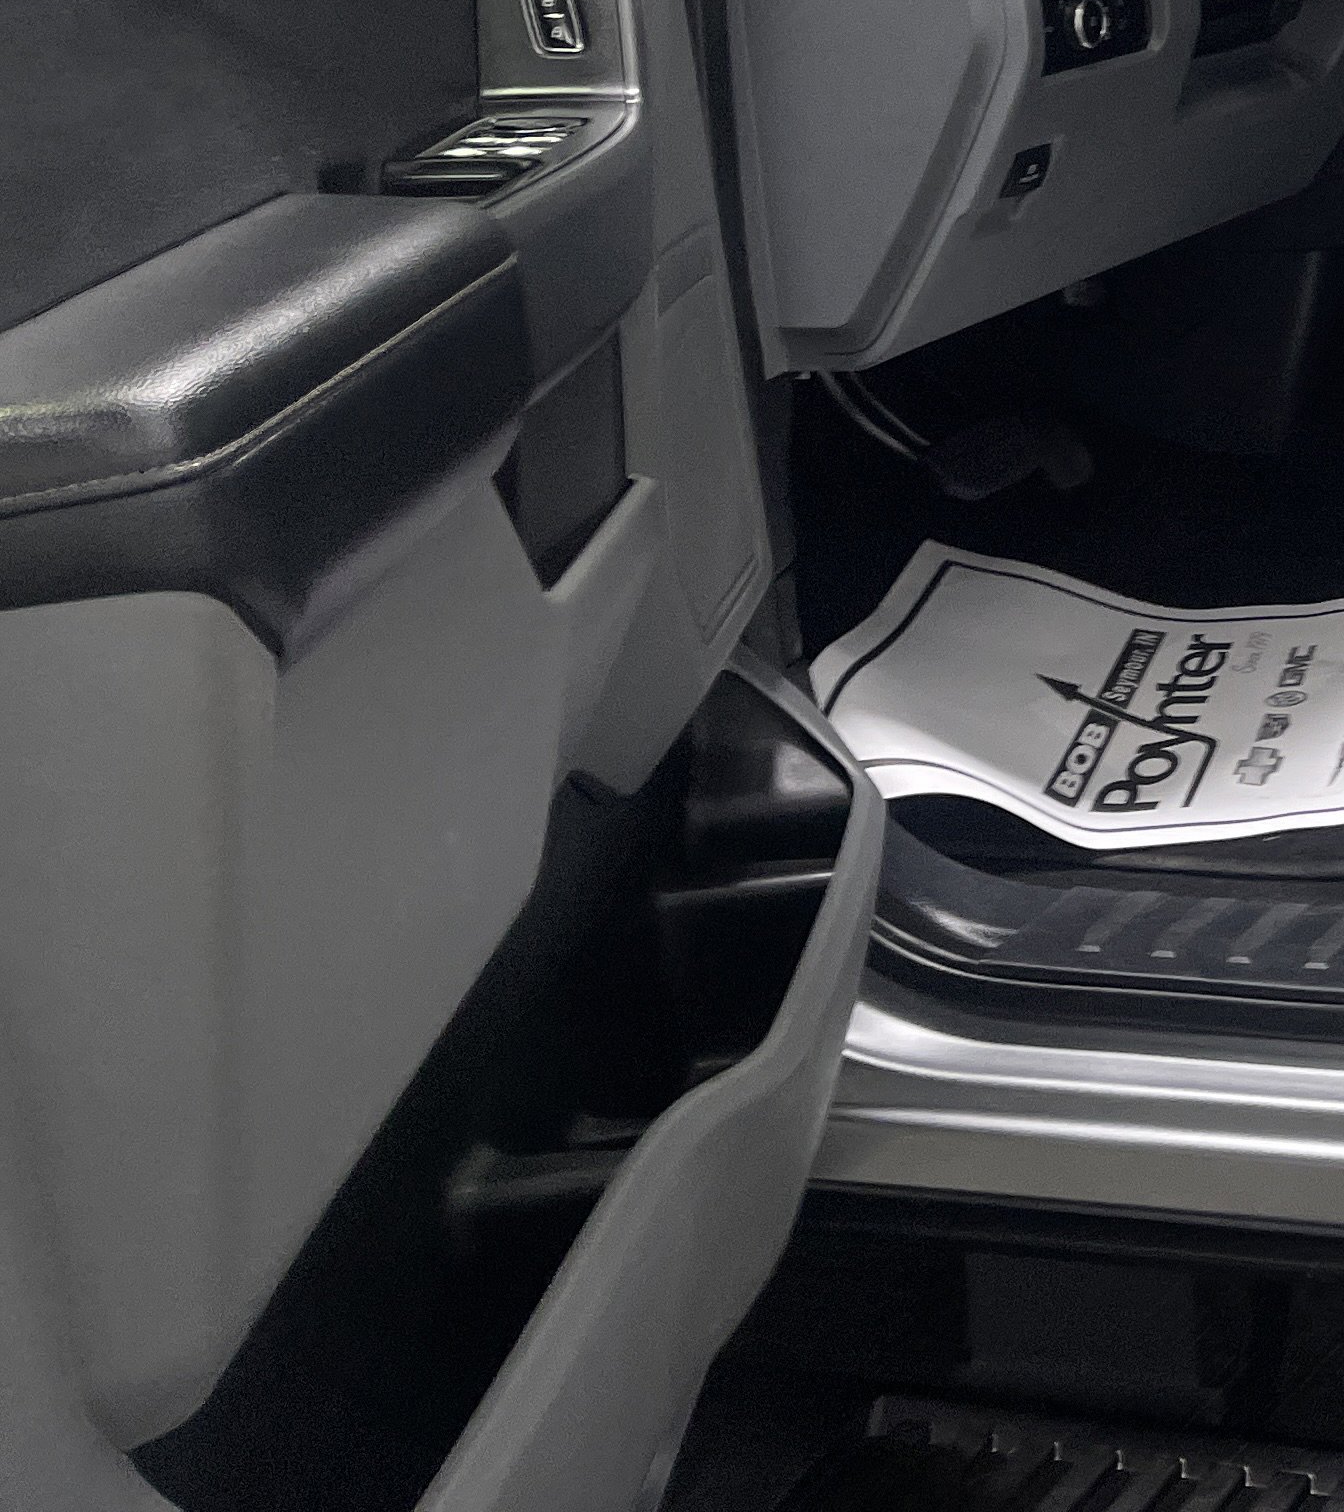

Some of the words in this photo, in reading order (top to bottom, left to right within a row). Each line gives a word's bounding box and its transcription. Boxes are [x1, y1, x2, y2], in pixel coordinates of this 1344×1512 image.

[1053, 722, 1111, 799] BOB
[1131, 631, 1163, 646] IN
[1090, 633, 1234, 812] Poynter
